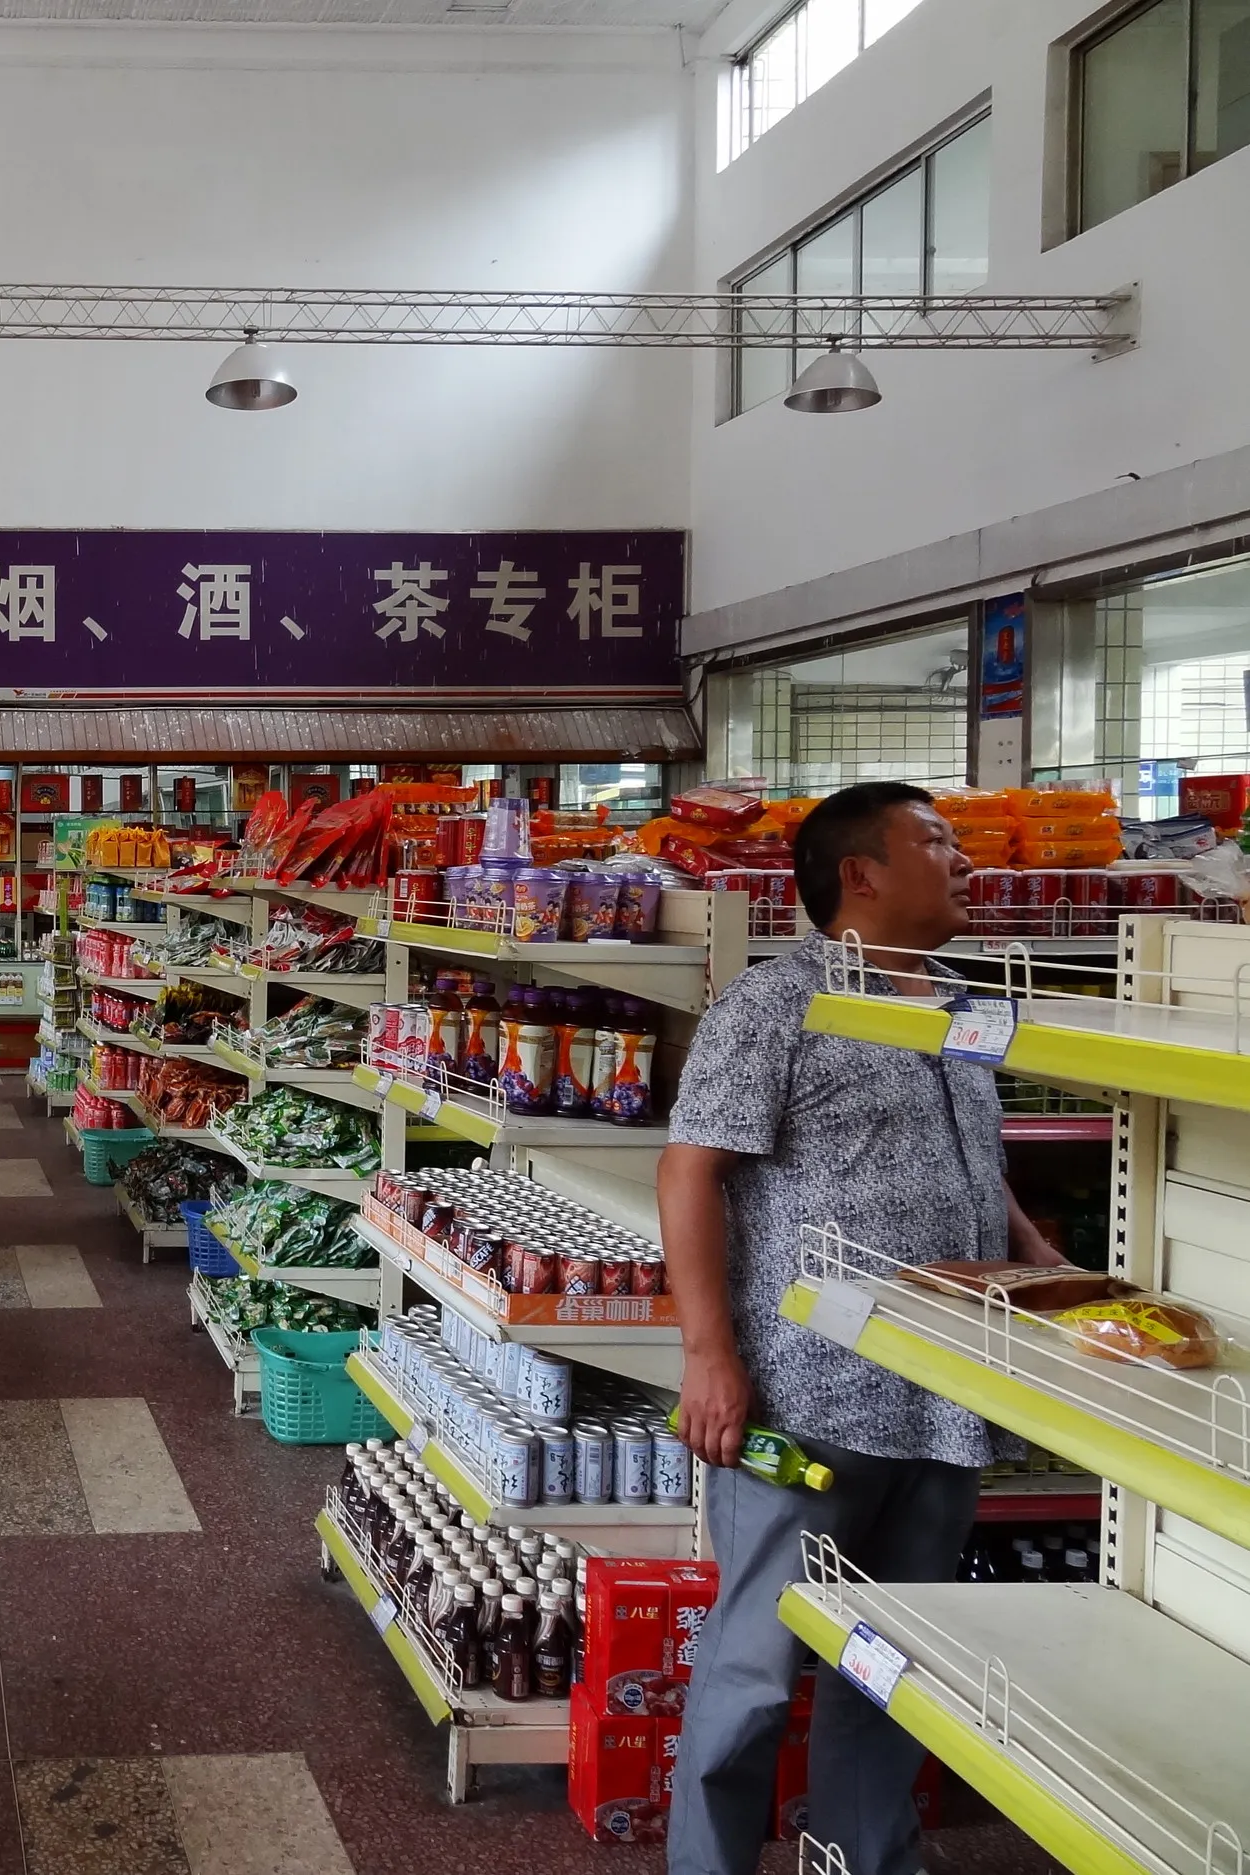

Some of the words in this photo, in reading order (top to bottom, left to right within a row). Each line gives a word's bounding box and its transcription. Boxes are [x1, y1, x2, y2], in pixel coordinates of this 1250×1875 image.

[555, 1297, 654, 1322] 雀巢咖啡
[630, 1606, 660, 1620] 八星
